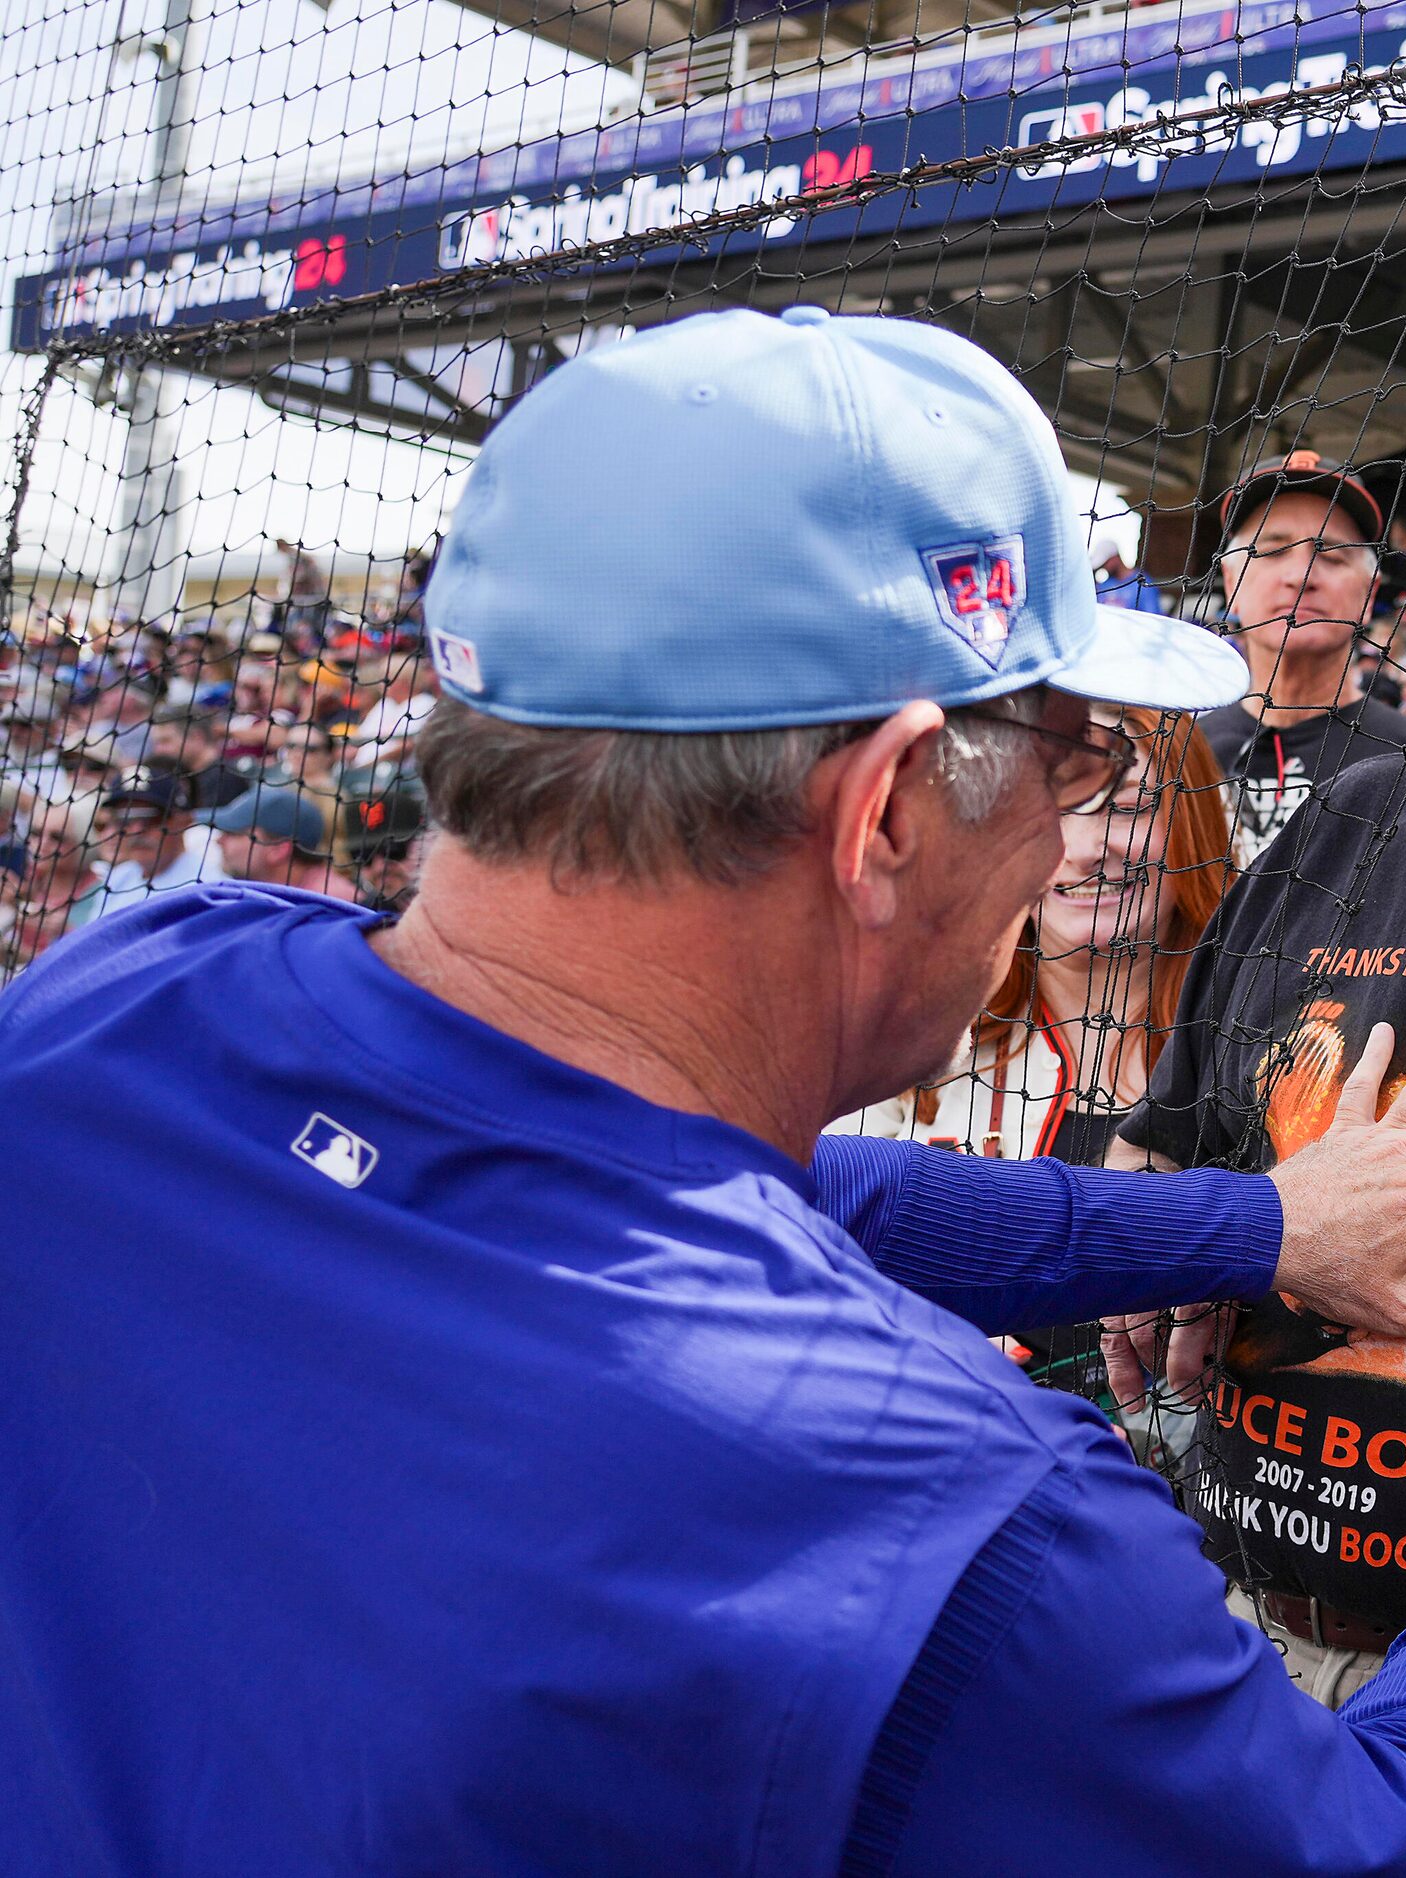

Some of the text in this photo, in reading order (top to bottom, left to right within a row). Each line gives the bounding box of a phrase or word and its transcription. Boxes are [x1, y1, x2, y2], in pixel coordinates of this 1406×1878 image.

[949, 558, 1018, 614] 24
[1301, 945, 1406, 977] THANKS
[1198, 1468, 1262, 1532] HANK
[1267, 1500, 1331, 1554] YOU
[1254, 1456, 1304, 1493] 2007
[1319, 1475, 1377, 1514] 2019
